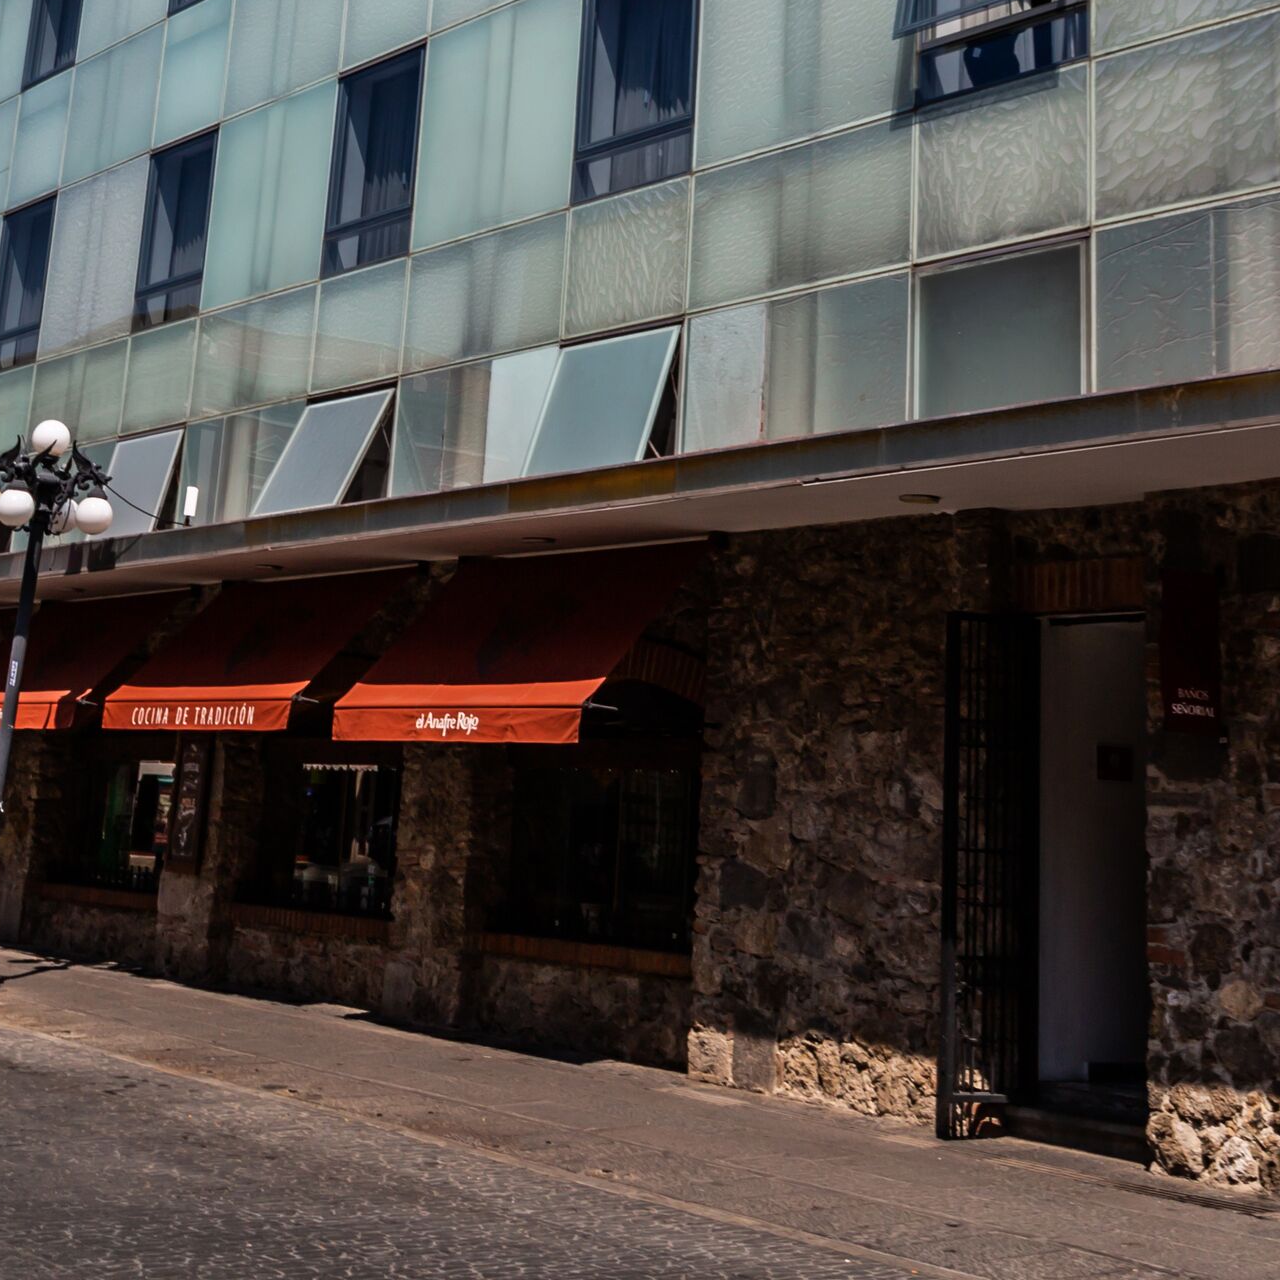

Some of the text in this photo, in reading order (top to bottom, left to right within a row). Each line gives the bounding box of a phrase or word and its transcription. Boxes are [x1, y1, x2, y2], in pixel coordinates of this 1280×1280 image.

[131, 702, 255, 725] COCINA DE TRADICIÓN
[415, 711, 479, 737] el Anafre Rojo
